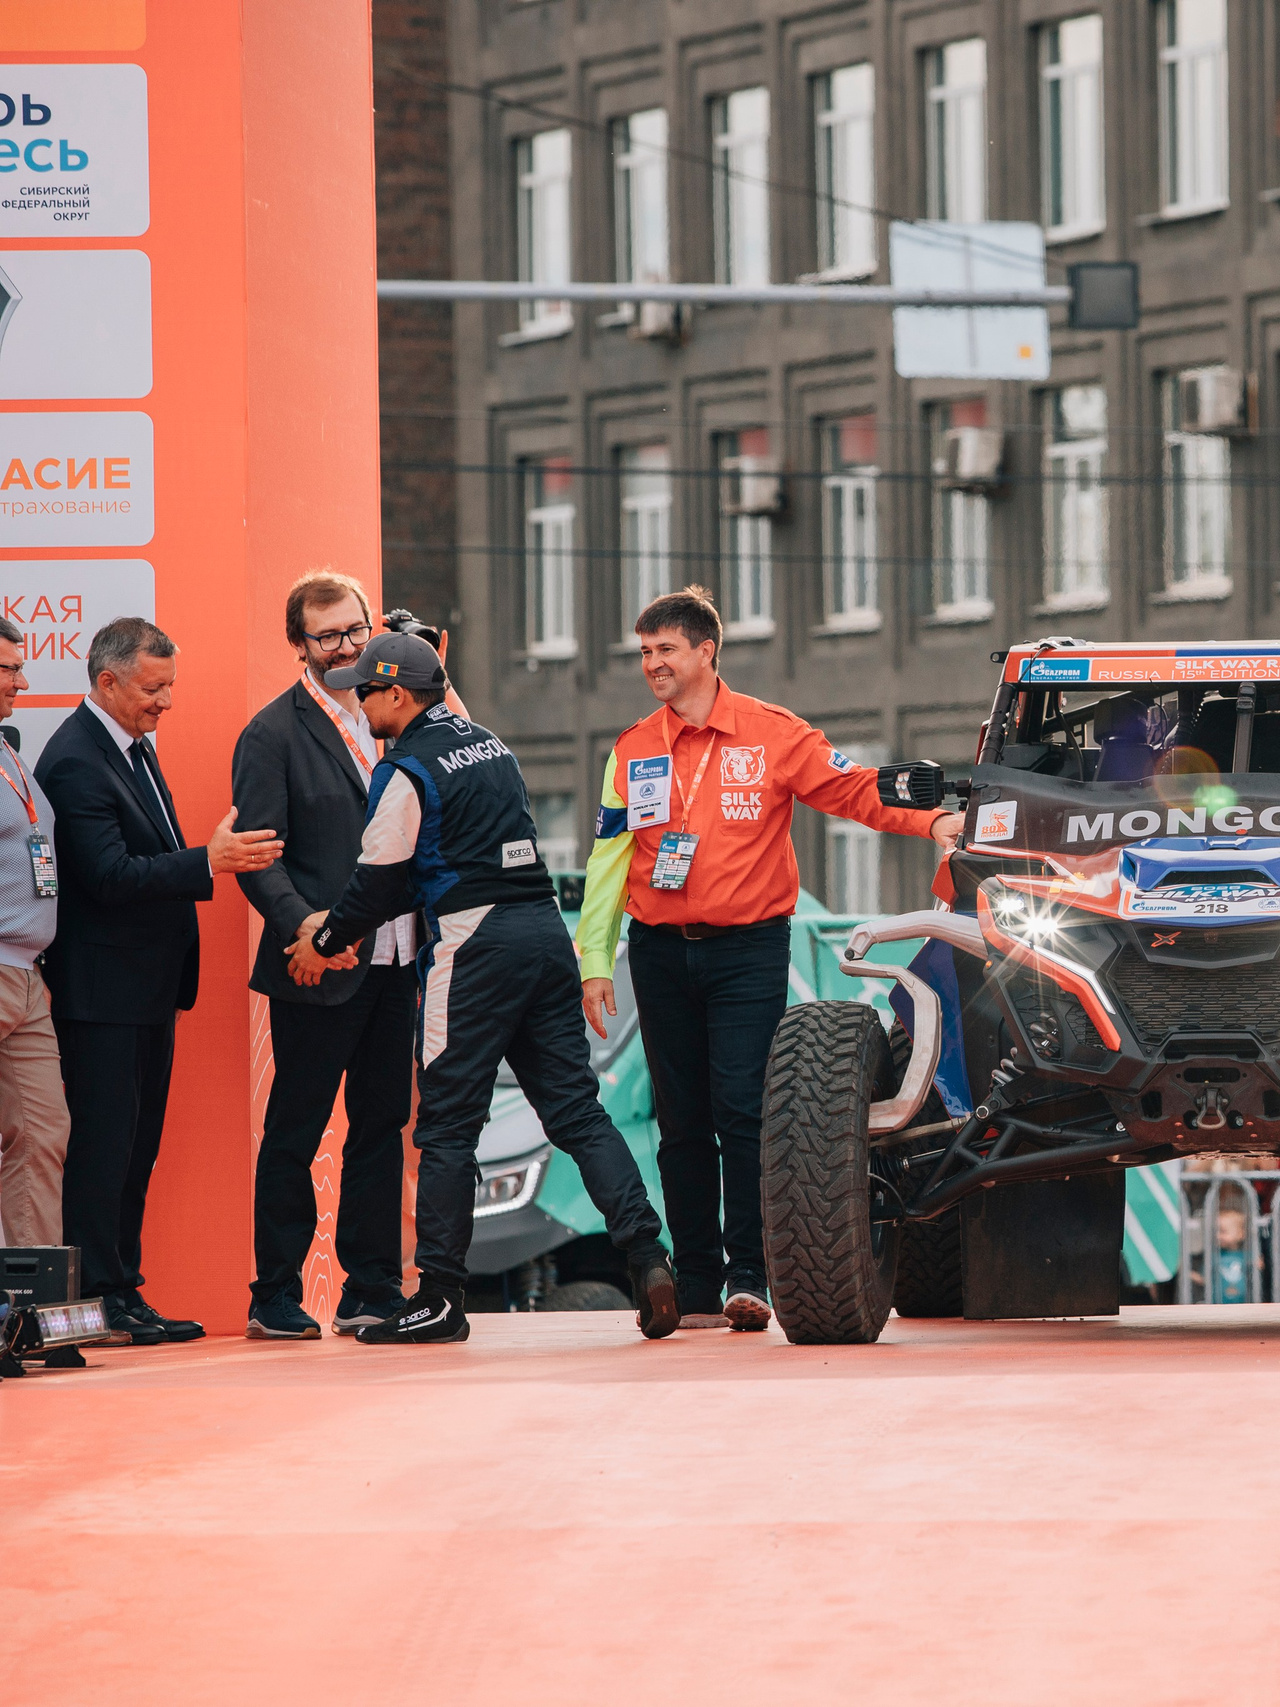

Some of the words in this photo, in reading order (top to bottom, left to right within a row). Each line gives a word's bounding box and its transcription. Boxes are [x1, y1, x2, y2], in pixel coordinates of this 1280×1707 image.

[20, 184, 90, 196] СИБИРСКИЙ
[1, 197, 90, 210] ФЕДЕРАЛЬНЫЙ
[53, 212, 90, 221] ОКРУГ
[0, 457, 131, 490] АСИЕ
[0, 500, 131, 517] трахование
[1175, 660, 1215, 670] SILK
[1217, 659, 1262, 669] WAY
[1098, 670, 1161, 680] RUSSIA
[1180, 669, 1206, 679] 15th
[1210, 668, 1280, 679] EDITION
[721, 792, 762, 806] SILK
[721, 807, 762, 820] WAY
[981, 825, 997, 834] 80
[507, 848, 531, 858] sparco
[1141, 891, 1217, 899] SILK
[1193, 903, 1229, 914] 218
